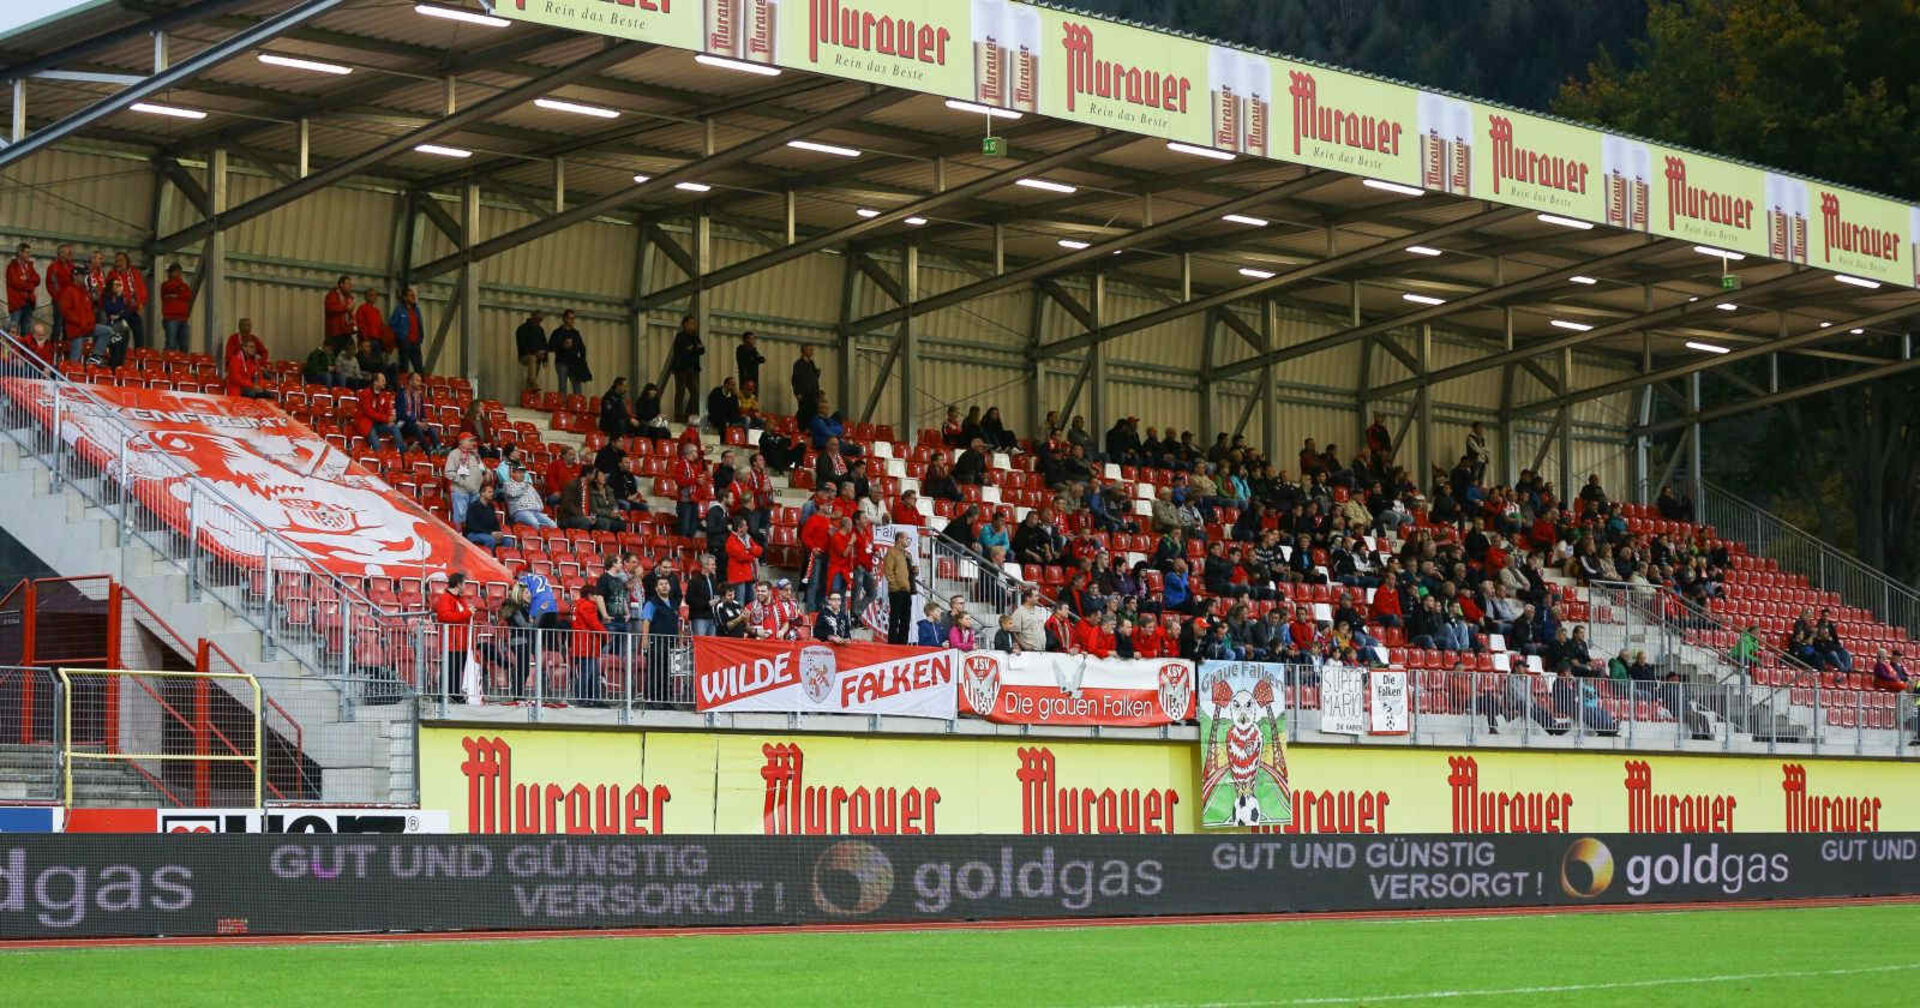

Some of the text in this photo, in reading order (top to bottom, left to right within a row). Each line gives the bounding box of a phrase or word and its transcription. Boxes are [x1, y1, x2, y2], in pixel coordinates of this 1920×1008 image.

[545, 1, 575, 17] Rein
[581, 9, 604, 22] das
[610, 12, 646, 30] Beste
[809, 0, 950, 66] Murauer
[835, 53, 924, 81] Rein das Beste
[980, 34, 1001, 99] Murauer
[1016, 44, 1031, 102] Murauer
[1062, 21, 1190, 114] Murauer
[1090, 102, 1168, 128] Rein das Beste
[1218, 84, 1236, 145] Murauer
[1289, 69, 1402, 156] Murauer
[1489, 114, 1588, 194] Murauer
[1665, 155, 1753, 231] Murauer
[1821, 191, 1900, 263] Murauer
[701, 651, 793, 704] WILDE
[841, 654, 950, 709] FALKEN
[973, 657, 990, 671] KSV
[1167, 664, 1182, 678] KSV
[1323, 670, 1362, 693] SUPER
[1383, 674, 1395, 685] Die
[1005, 692, 1153, 720] Die grauen Falken
[1323, 693, 1362, 718] MARIO
[1378, 686, 1401, 698] Falken
[461, 736, 671, 834] Murauer
[761, 742, 941, 834] Murauer
[1016, 746, 1179, 834] Murauer
[1252, 790, 1390, 833] urauer
[1448, 755, 1573, 833] Murauer
[1624, 759, 1737, 833] Murauer
[1782, 763, 1882, 833] Murauer
[270, 839, 709, 878] GUT UND GÜNSTIG
[1212, 838, 1495, 870] GUT UND GÜNSTIG
[1626, 843, 1789, 896] goldgas
[1821, 839, 1917, 861] GUT UND
[513, 881, 763, 917] VERSORGT
[913, 847, 1163, 912] goldgas
[1369, 872, 1529, 900] VERSORGT
